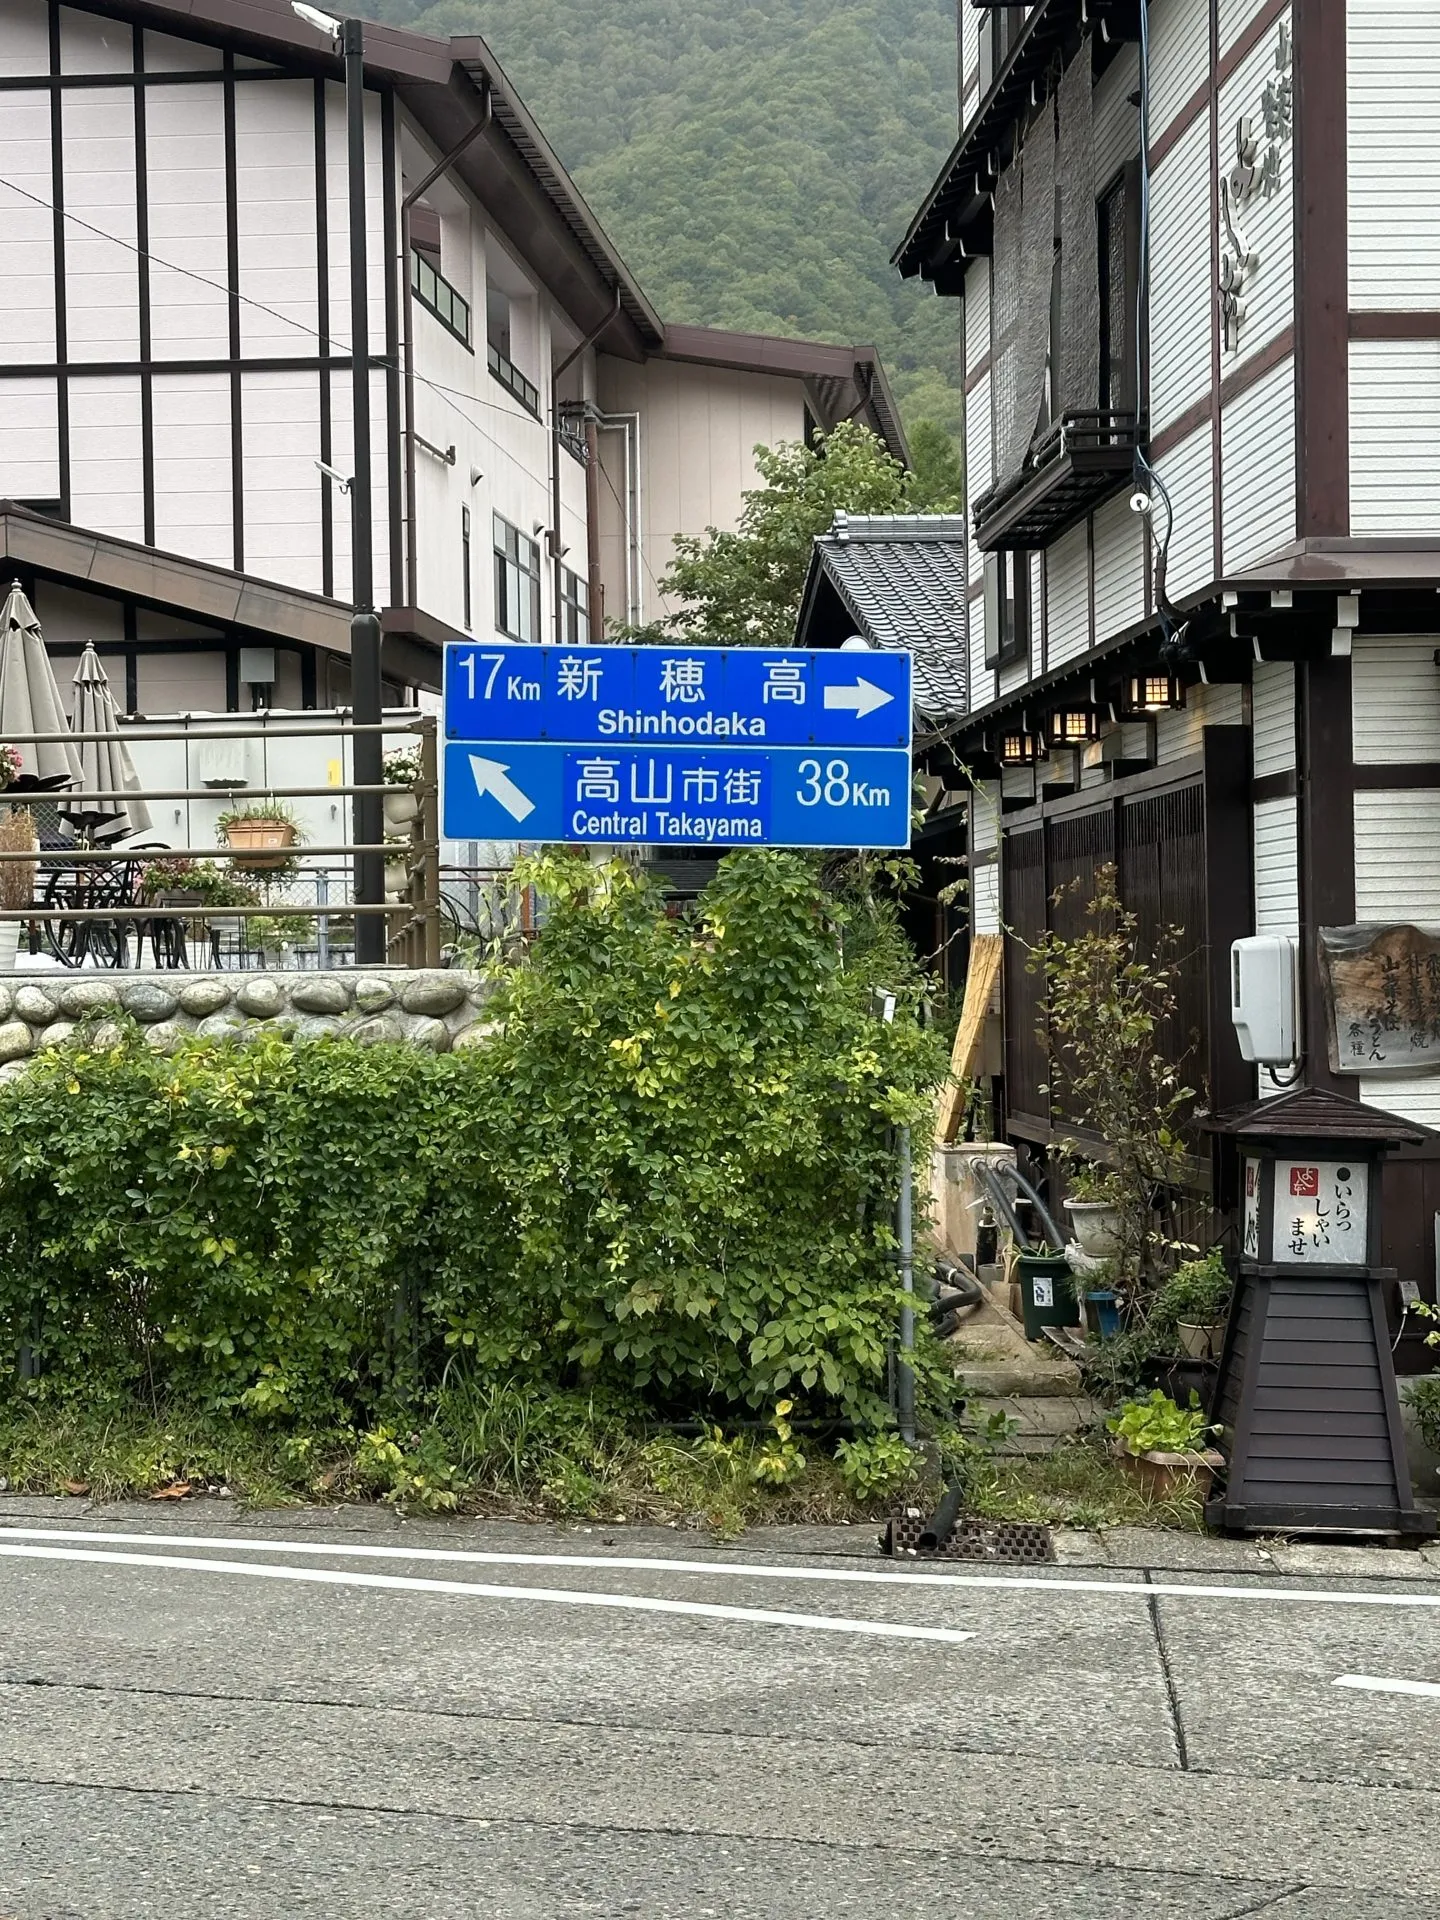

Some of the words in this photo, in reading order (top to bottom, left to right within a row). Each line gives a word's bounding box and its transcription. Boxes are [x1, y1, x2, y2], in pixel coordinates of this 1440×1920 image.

[459, 653, 541, 701] 17Km
[557, 655, 807, 705] 新穂高
[598, 709, 766, 736] Shinhodaka
[576, 756, 762, 805] 高山市街
[796, 759, 890, 807] 38Km
[572, 810, 647, 835] Central
[655, 811, 762, 841] Takayama
[1347, 1022, 1366, 1057] 各種
[1368, 1017, 1387, 1061] うどん
[1312, 1198, 1330, 1248] しゃい
[1334, 1184, 1352, 1231] いらっ
[1288, 1217, 1307, 1256] ませ
